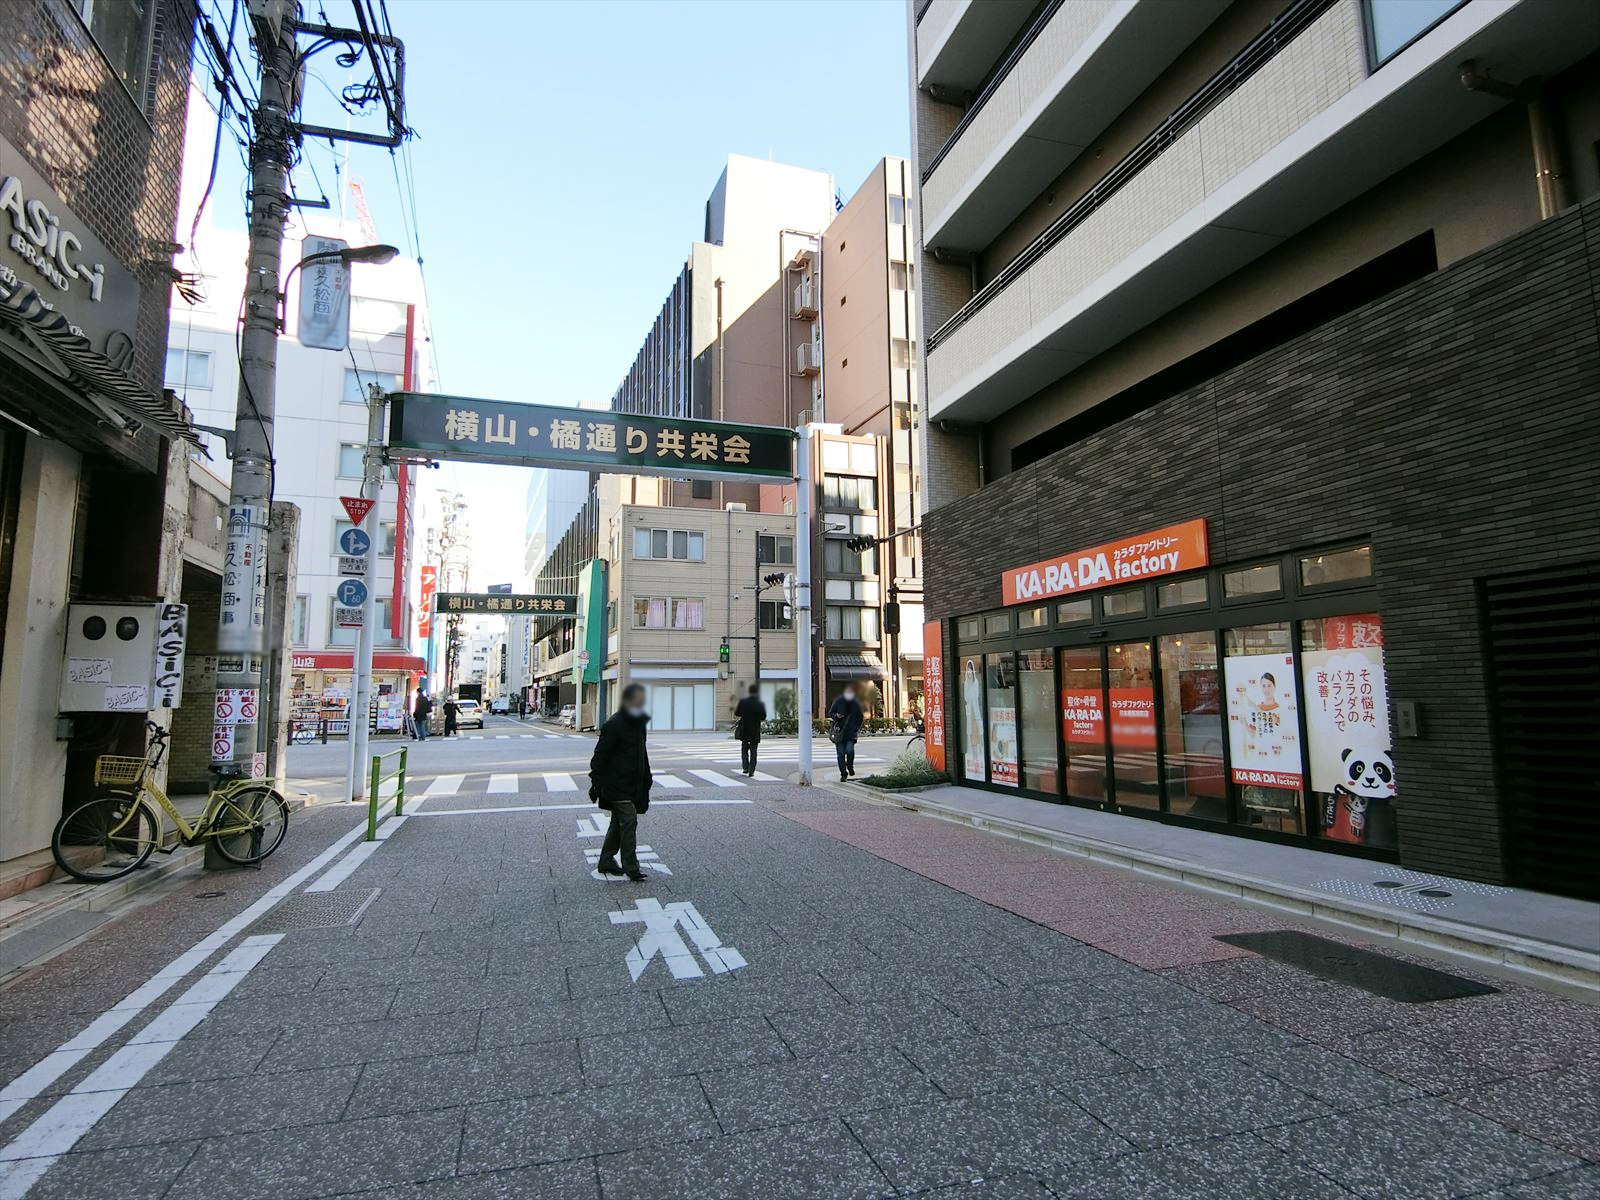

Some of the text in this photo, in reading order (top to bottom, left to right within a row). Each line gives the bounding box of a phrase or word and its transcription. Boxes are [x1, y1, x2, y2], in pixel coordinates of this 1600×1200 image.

[11, 232, 69, 292] BRAND
[445, 409, 751, 464] 横山・橘通り共栄会
[347, 501, 368, 509] 止まれ
[244, 543, 253, 566] 不動産
[1114, 536, 1178, 560] カラダファクトリー
[1114, 551, 1179, 579] factory
[343, 585, 356, 603] P
[351, 595, 360, 603] 60
[449, 597, 566, 611] 横山・橘通り共栄会
[1336, 621, 1346, 650] カラ
[291, 657, 315, 667] 山店
[1330, 670, 1345, 732] バランスで
[1345, 670, 1359, 722] カラダの
[1359, 669, 1376, 728] その悩み、
[1073, 720, 1093, 730] factory
